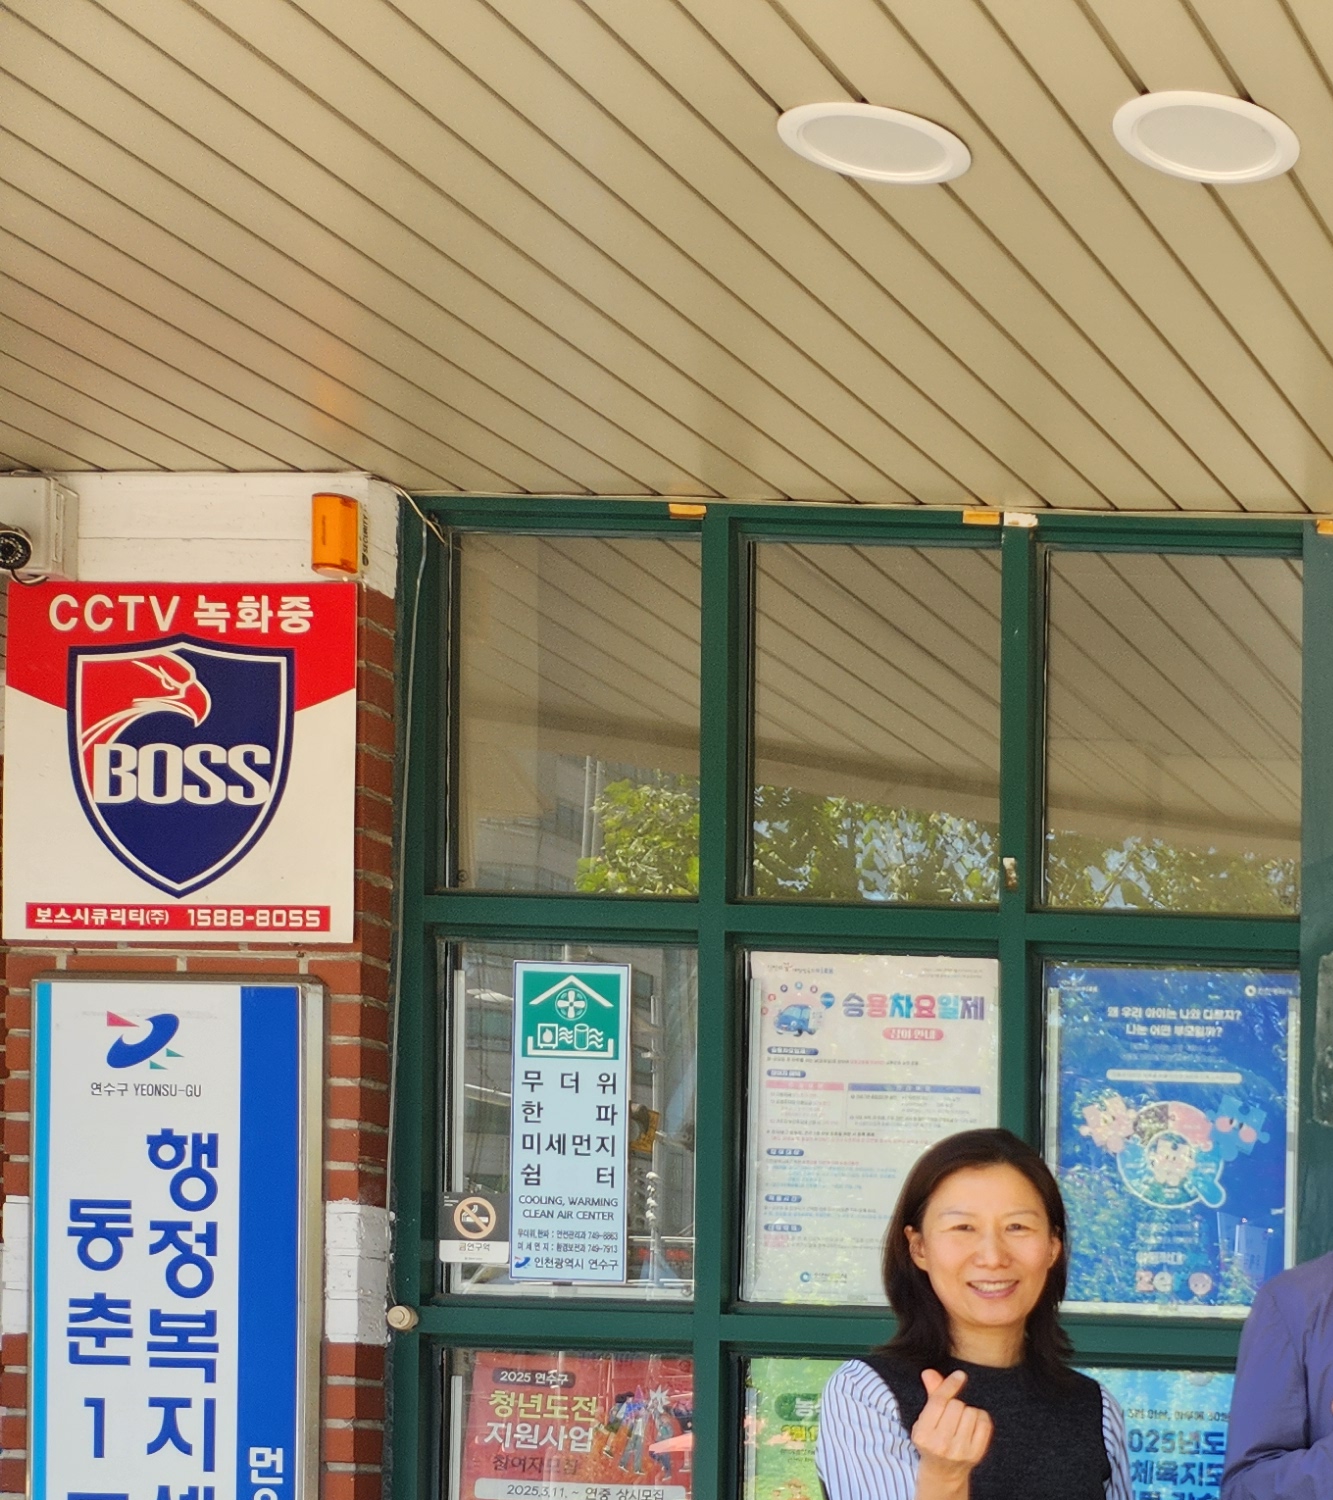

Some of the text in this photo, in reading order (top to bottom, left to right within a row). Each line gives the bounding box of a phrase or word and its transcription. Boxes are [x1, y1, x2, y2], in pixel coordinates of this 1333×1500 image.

[48, 594, 315, 634] CCTV 녹화중
[92, 743, 272, 805] BOSS
[34, 907, 321, 928] 보스시큐리티(주) 1588-8055
[841, 992, 985, 1021] 승용차요일제
[90, 1081, 202, 1099] 연수구 YEONSU-GU
[521, 1133, 617, 1158] 미세먼지
[519, 1194, 619, 1208] COOLING, WARMING
[522, 1208, 615, 1221] CLEAN AIR CENTER
[533, 1256, 619, 1271] 인천광역시 연수구
[499, 1370, 570, 1386] 2025 연수구
[487, 1389, 598, 1423] 청년도전
[483, 1421, 595, 1453] 지원사업
